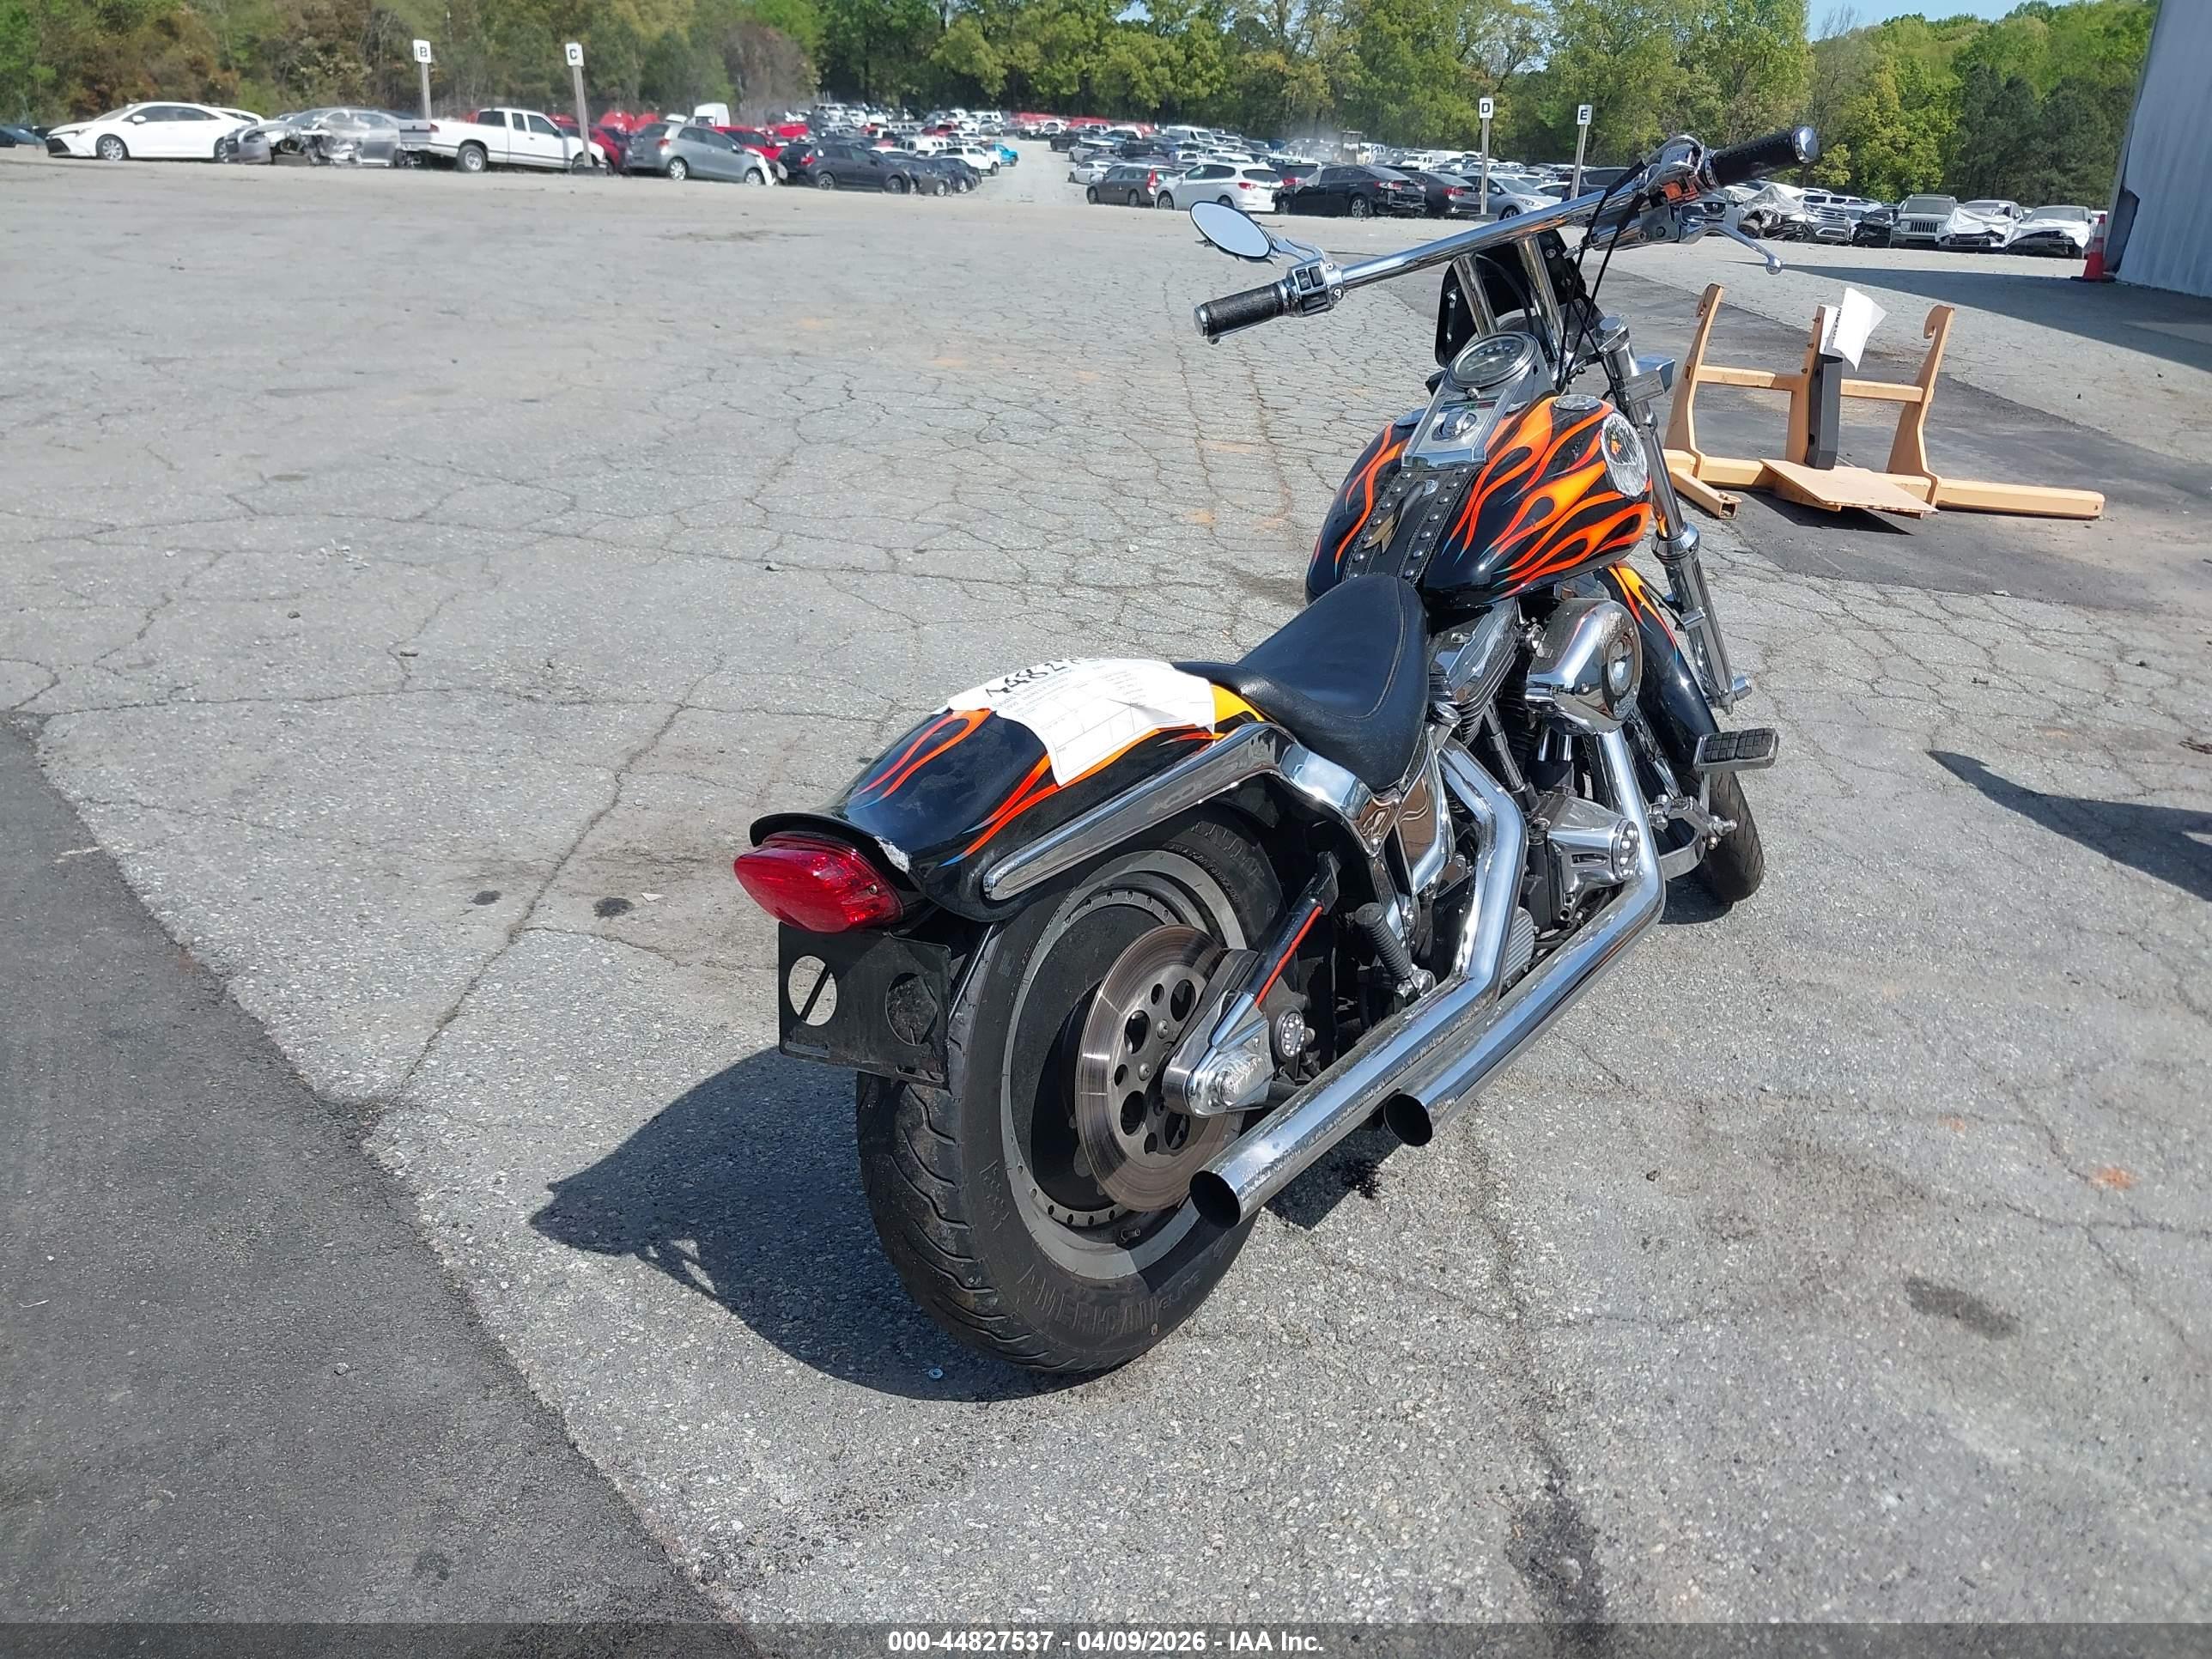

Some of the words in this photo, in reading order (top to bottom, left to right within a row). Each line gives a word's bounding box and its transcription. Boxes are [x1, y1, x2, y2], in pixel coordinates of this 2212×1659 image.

[419, 46, 428, 58] B
[569, 48, 578, 60] C
[1481, 102, 1491, 113] D
[1579, 109, 1589, 120] E
